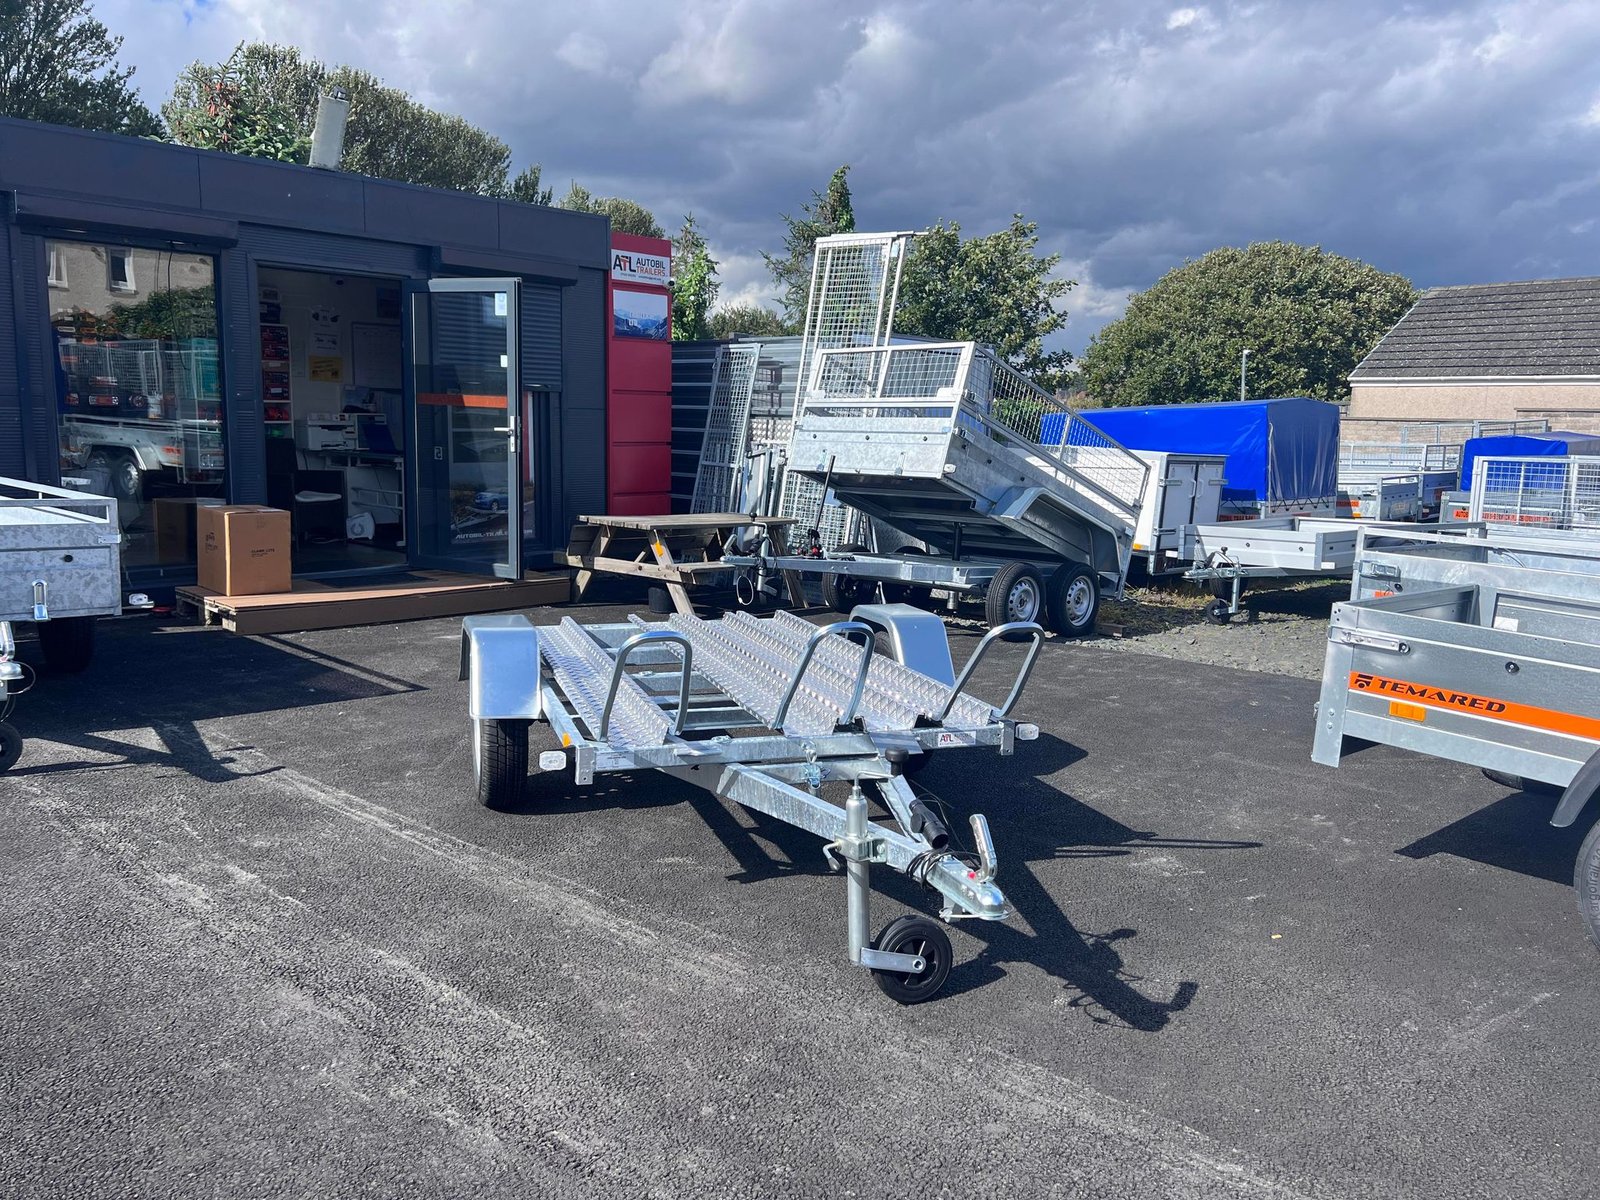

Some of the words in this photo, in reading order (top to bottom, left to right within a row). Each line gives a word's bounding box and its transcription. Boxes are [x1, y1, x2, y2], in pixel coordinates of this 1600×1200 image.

[613, 254, 636, 272] ATL
[636, 258, 666, 269] AUTOBIL
[636, 266, 666, 277] TRAILERS
[1378, 678, 1506, 713] TEMARED
